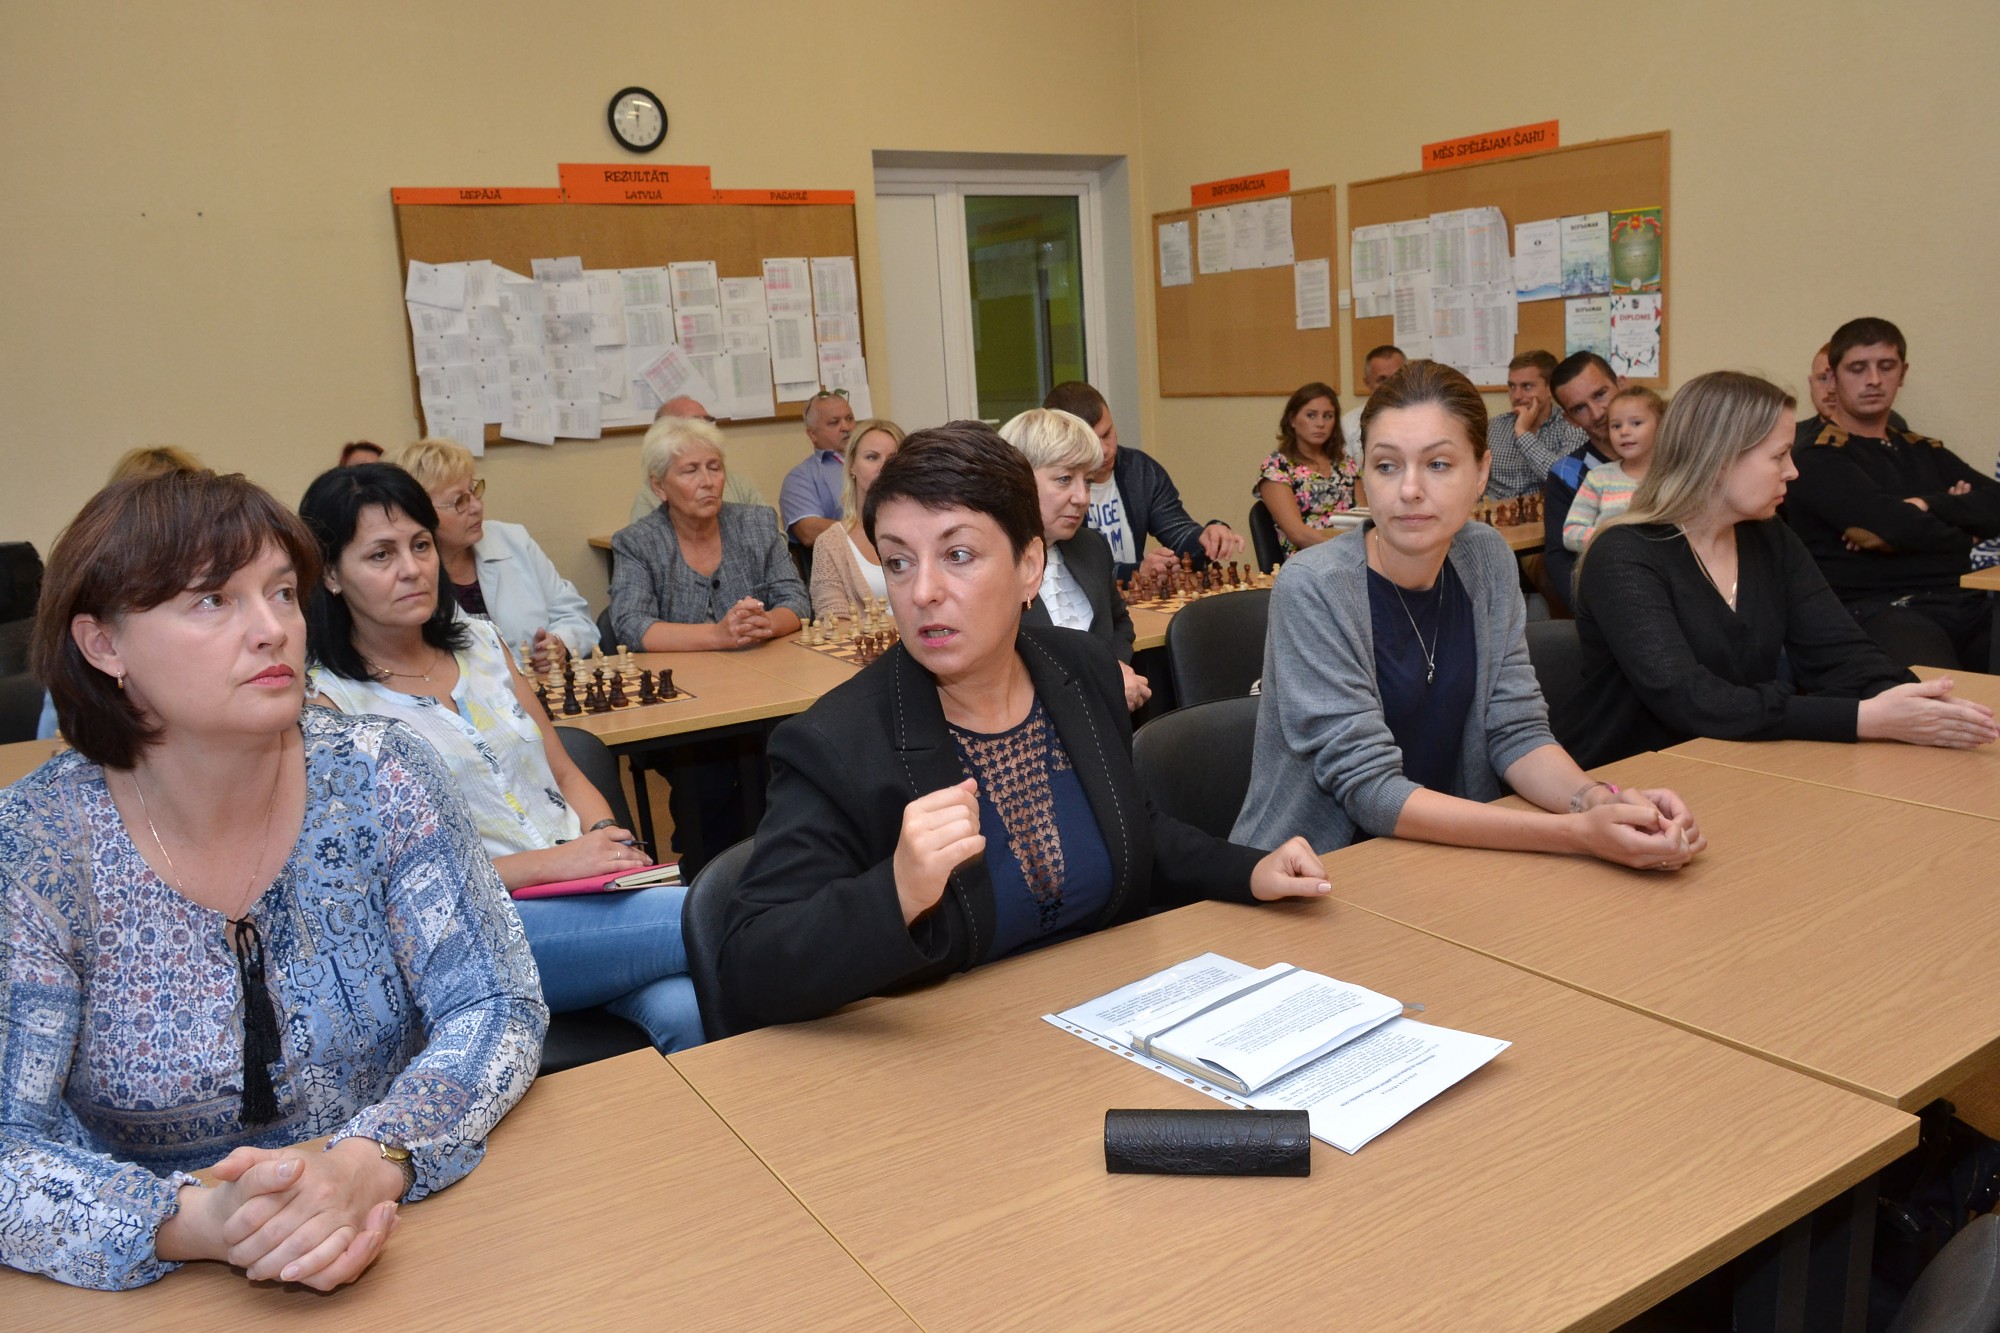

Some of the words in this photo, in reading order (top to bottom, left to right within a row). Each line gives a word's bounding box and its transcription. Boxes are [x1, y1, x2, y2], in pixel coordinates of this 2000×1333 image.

[1432, 145, 1455, 161] MĒS
[1457, 136, 1511, 157] SPĒLĒJAM
[1513, 129, 1545, 147] ŠAHU
[603, 169, 670, 183] REZULTĀTI
[1211, 178, 1266, 197] INFORMĀCIJA
